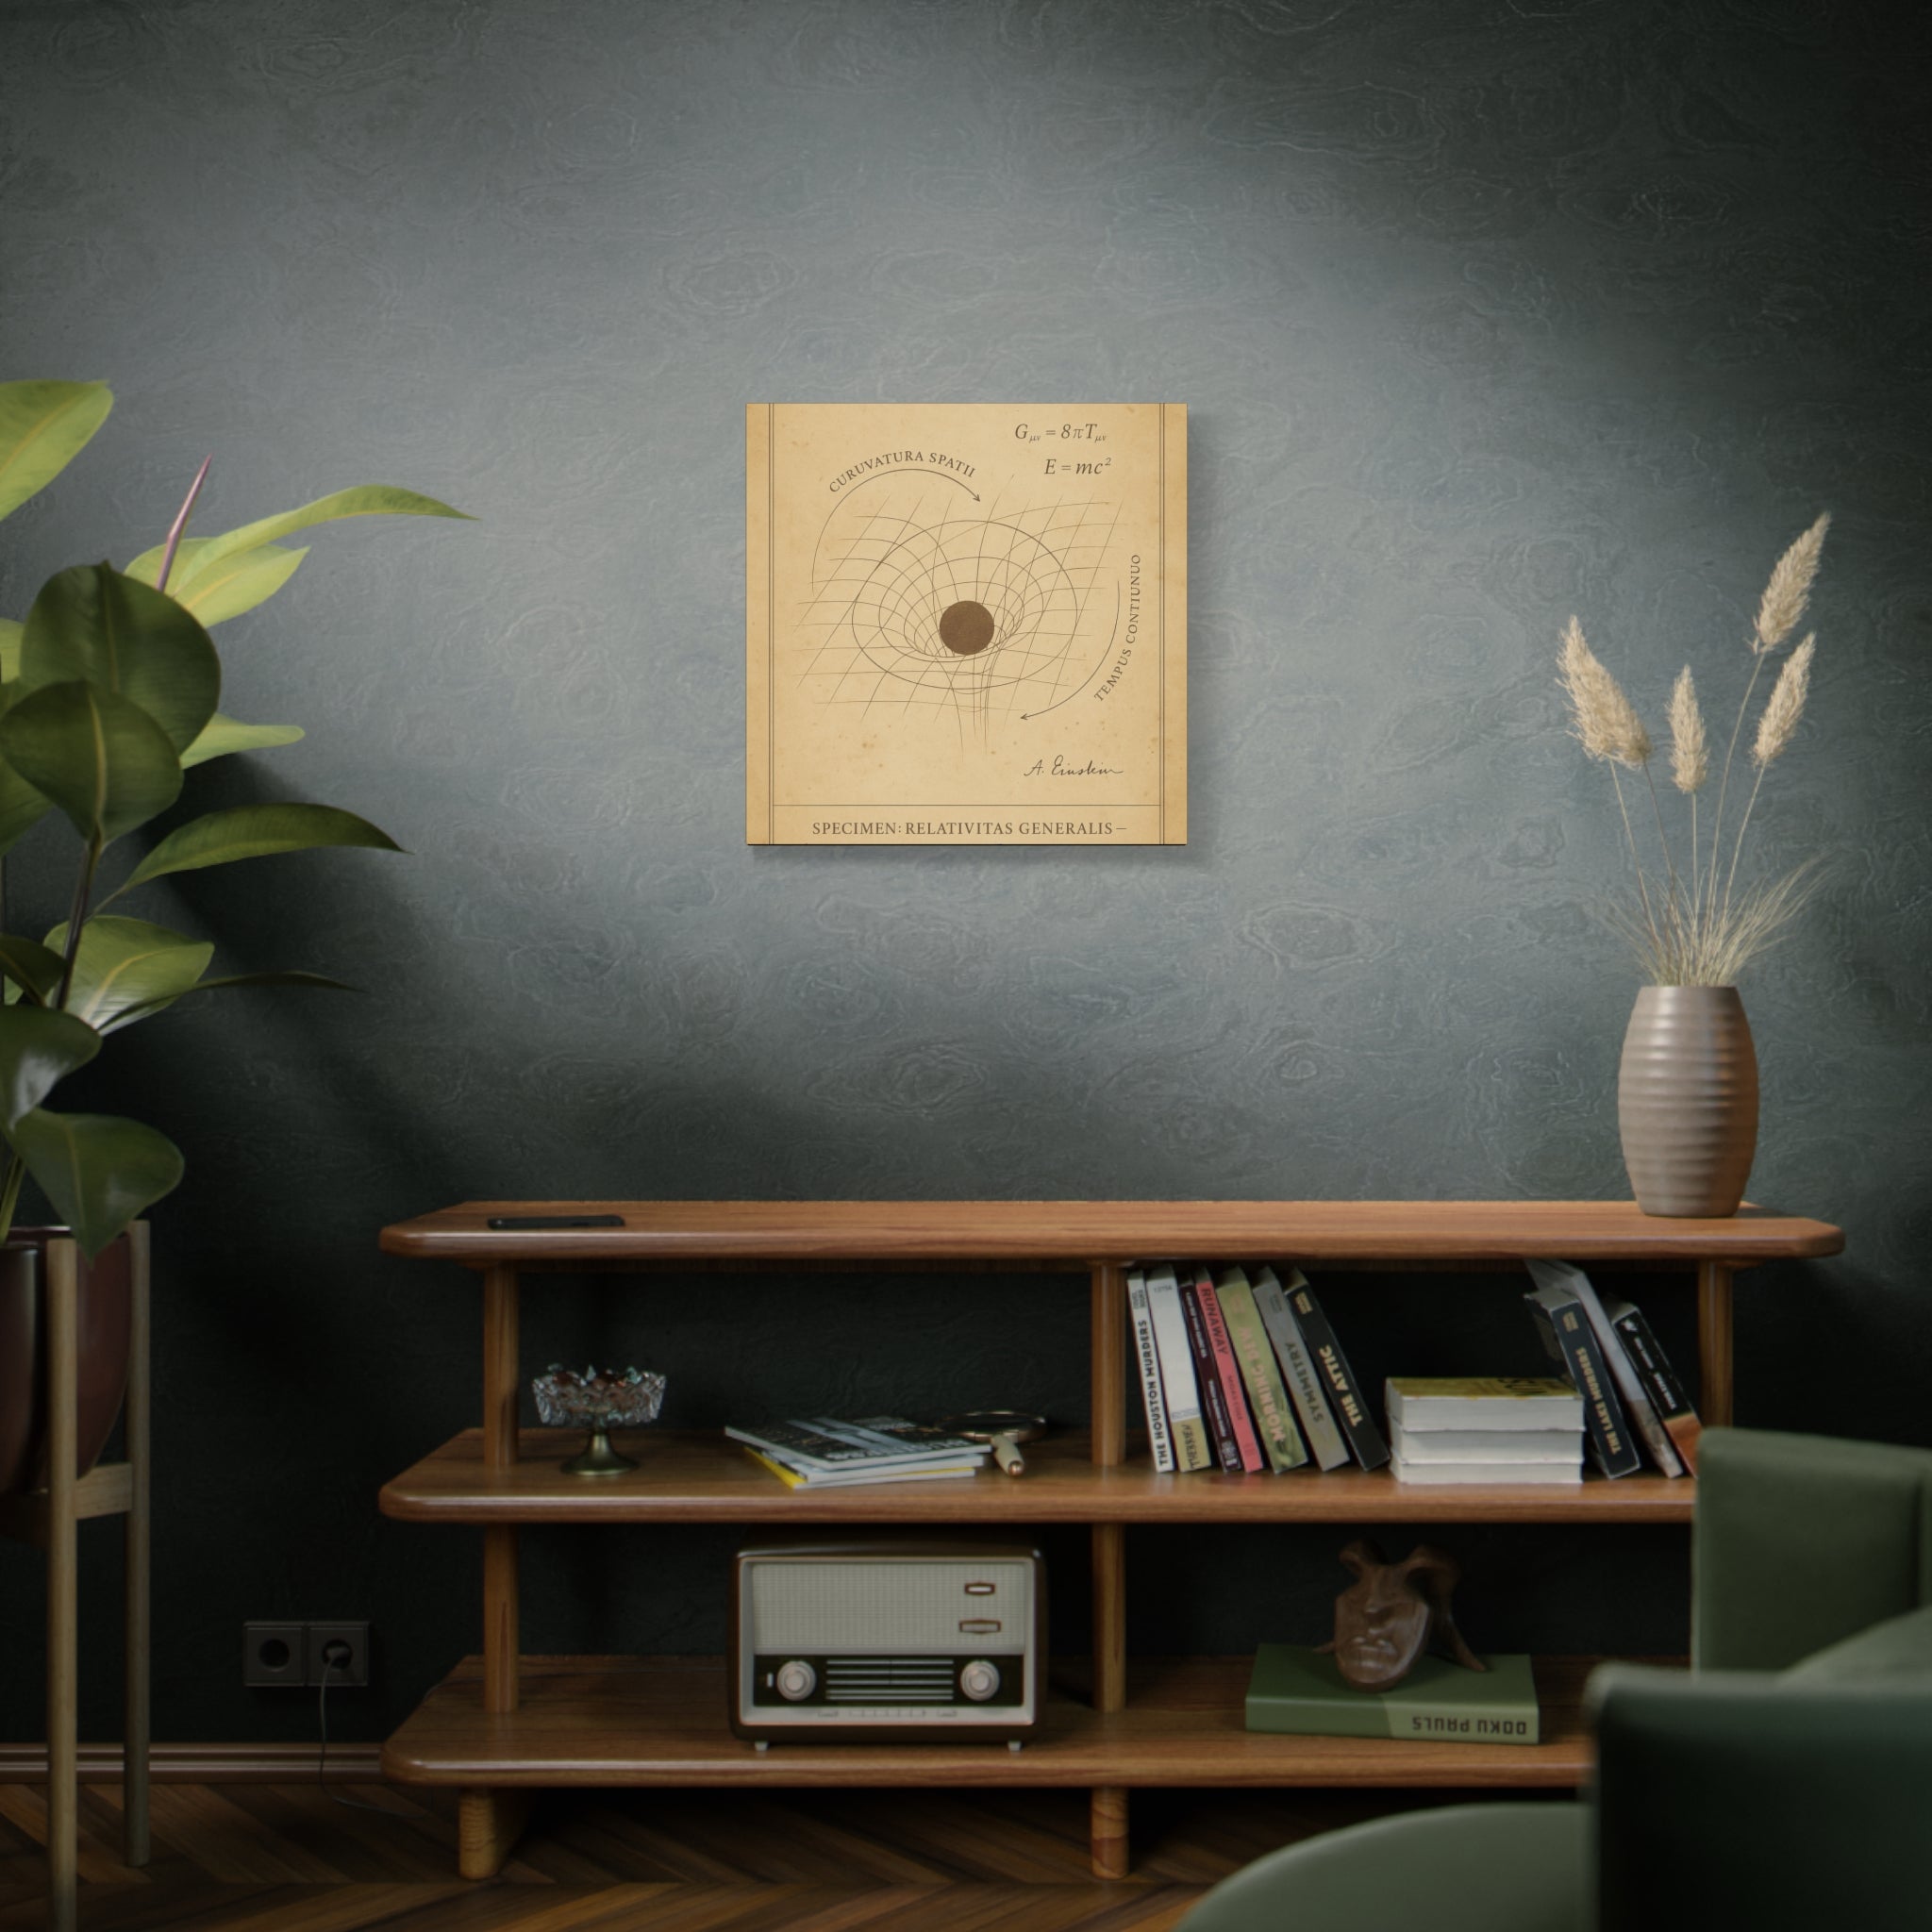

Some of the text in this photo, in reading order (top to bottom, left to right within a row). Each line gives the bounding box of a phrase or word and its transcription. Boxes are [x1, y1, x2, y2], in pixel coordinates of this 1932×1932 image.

[829, 450, 976, 492] CURUVATURA SPATII
[1093, 554, 1141, 702] TEMPUS CONTIUNUO
[812, 821, 903, 836] SPECIMEN:
[905, 821, 1014, 836] RELATIVITAS
[1138, 1319, 1156, 1377] MURDERS
[1201, 1288, 1229, 1355] RUNAWAY
[1146, 1381, 1165, 1441] HOUSTON
[1250, 1364, 1287, 1442] MORNING
[1285, 1341, 1324, 1424] SYMMETRY
[1318, 1343, 1364, 1428] THE ATTIC
[1156, 1442, 1170, 1467] THE
[1411, 1716, 1471, 1734] PAULS
